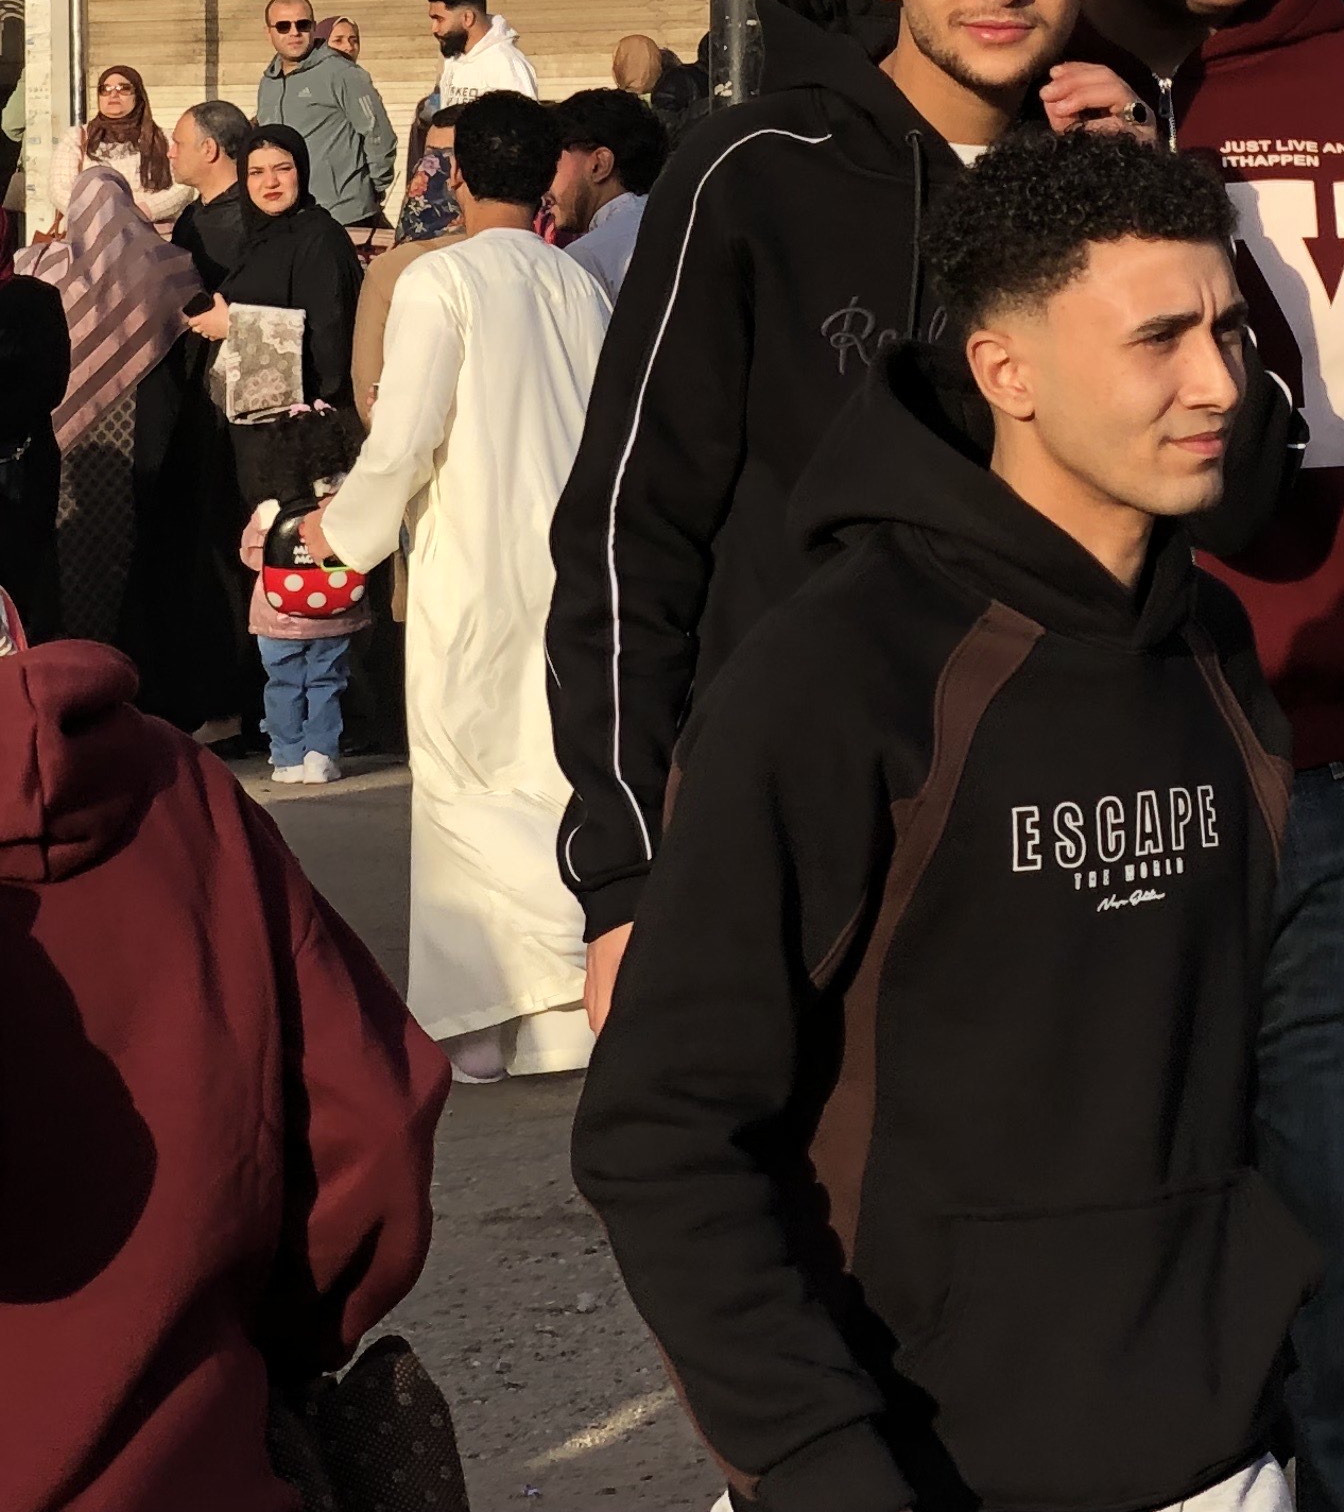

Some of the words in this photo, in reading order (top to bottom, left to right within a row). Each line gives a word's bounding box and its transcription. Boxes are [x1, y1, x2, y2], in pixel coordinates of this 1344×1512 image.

[1220, 139, 1272, 154] JUST
[1275, 138, 1319, 154] LIVE
[1011, 785, 1219, 872] ESCAPE
[1073, 868, 1110, 890] THE
